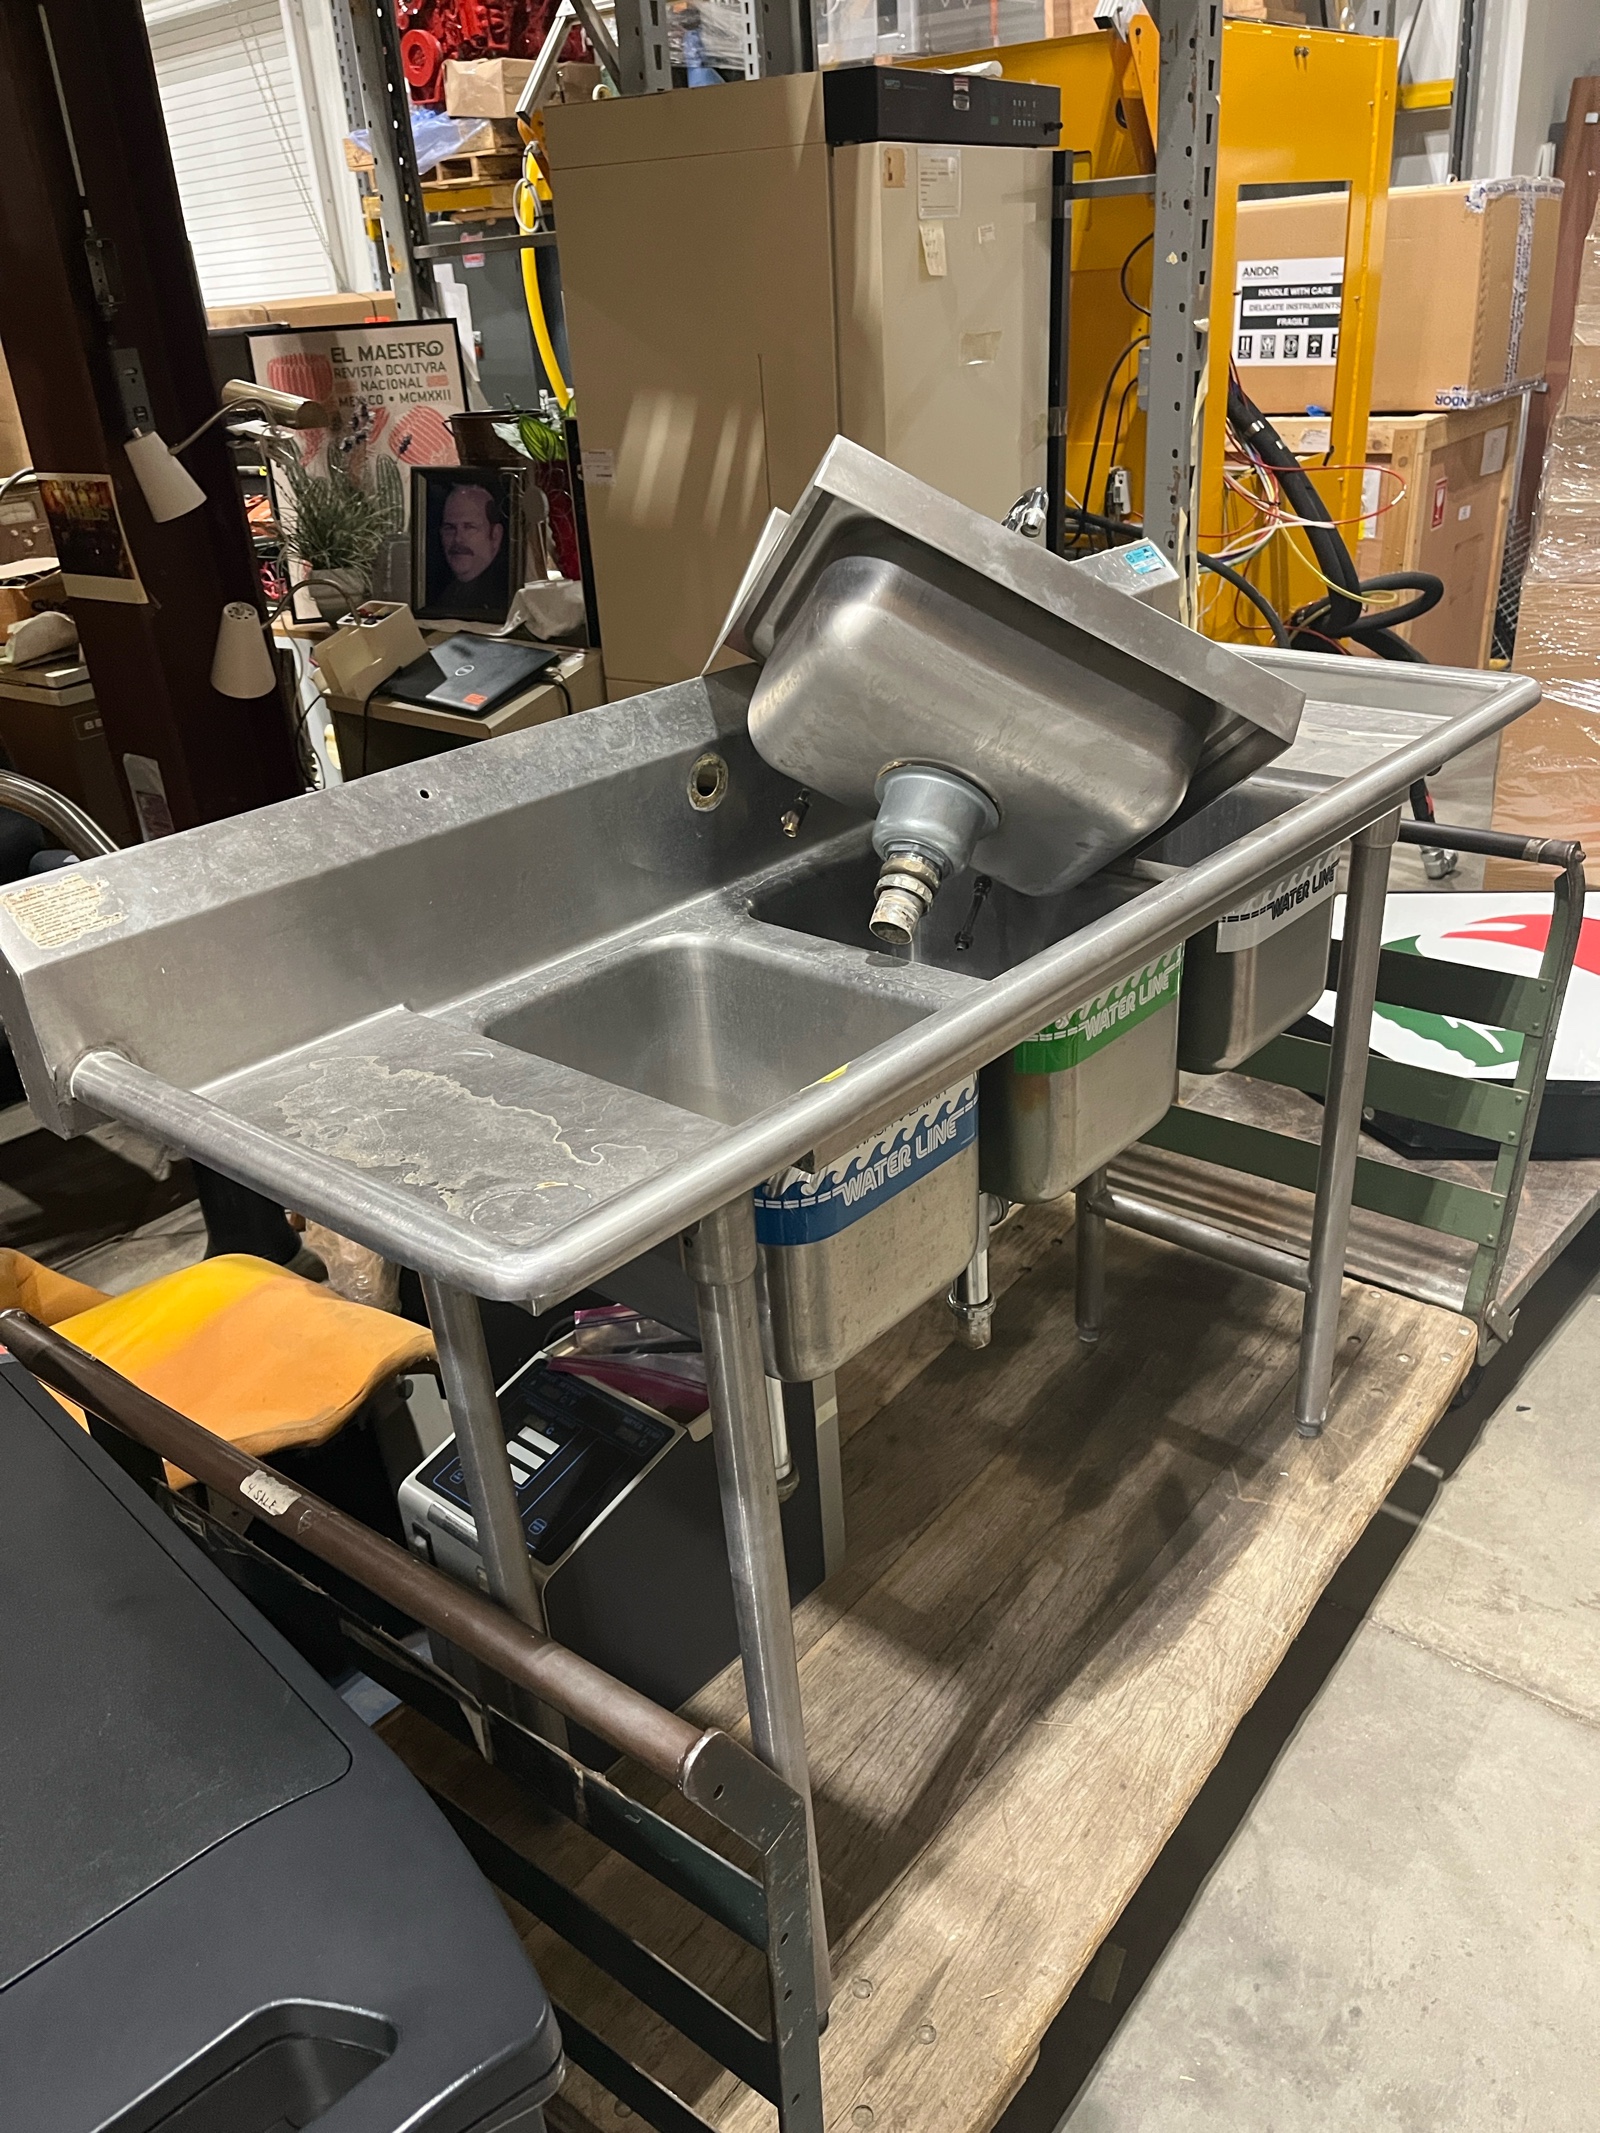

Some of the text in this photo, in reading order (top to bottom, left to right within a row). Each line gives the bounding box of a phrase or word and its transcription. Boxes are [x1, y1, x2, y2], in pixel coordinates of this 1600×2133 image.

[1242, 266, 1279, 277] ANDOR
[1258, 285, 1333, 297] HANDLE WITH CARE
[1249, 301, 1341, 312] DELICATE INSTRUMENTS
[1276, 317, 1309, 327] FRAGILE
[331, 340, 444, 363] EL MAESTRO
[333, 365, 382, 379] REVISTA
[360, 379, 423, 391] NACIONAL
[400, 389, 451, 404] MCMXXII
[1268, 865, 1335, 920] WATER LINE
[1080, 970, 1170, 1041] WATER LINE
[833, 1144, 911, 1207] WATER
[915, 1114, 961, 1159] LINE
